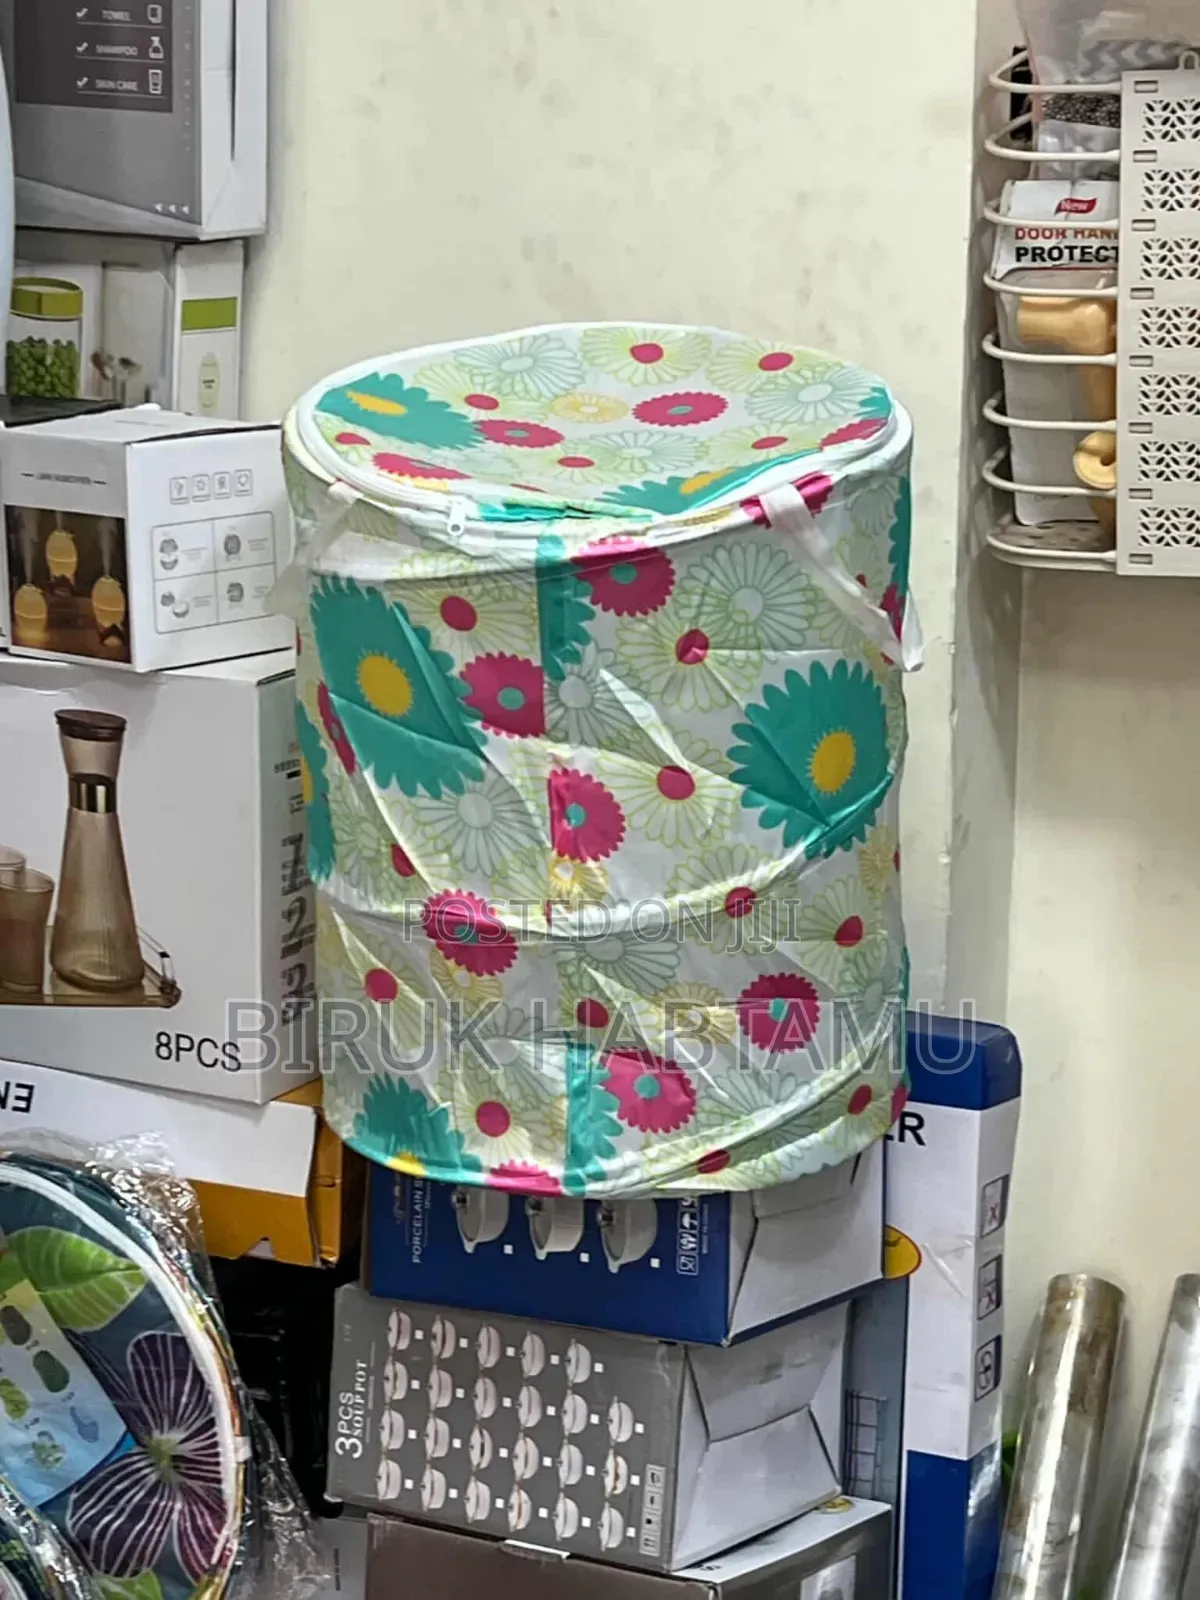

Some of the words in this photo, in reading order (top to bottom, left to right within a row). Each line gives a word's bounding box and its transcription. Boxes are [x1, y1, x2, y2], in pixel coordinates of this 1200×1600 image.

[1015, 227, 1067, 240] DOOR
[155, 1031, 242, 1072] 8PCS
[412, 1189, 424, 1263] PORCELAIN
[355, 1360, 368, 1391] POT
[353, 1395, 365, 1437] SOUP
